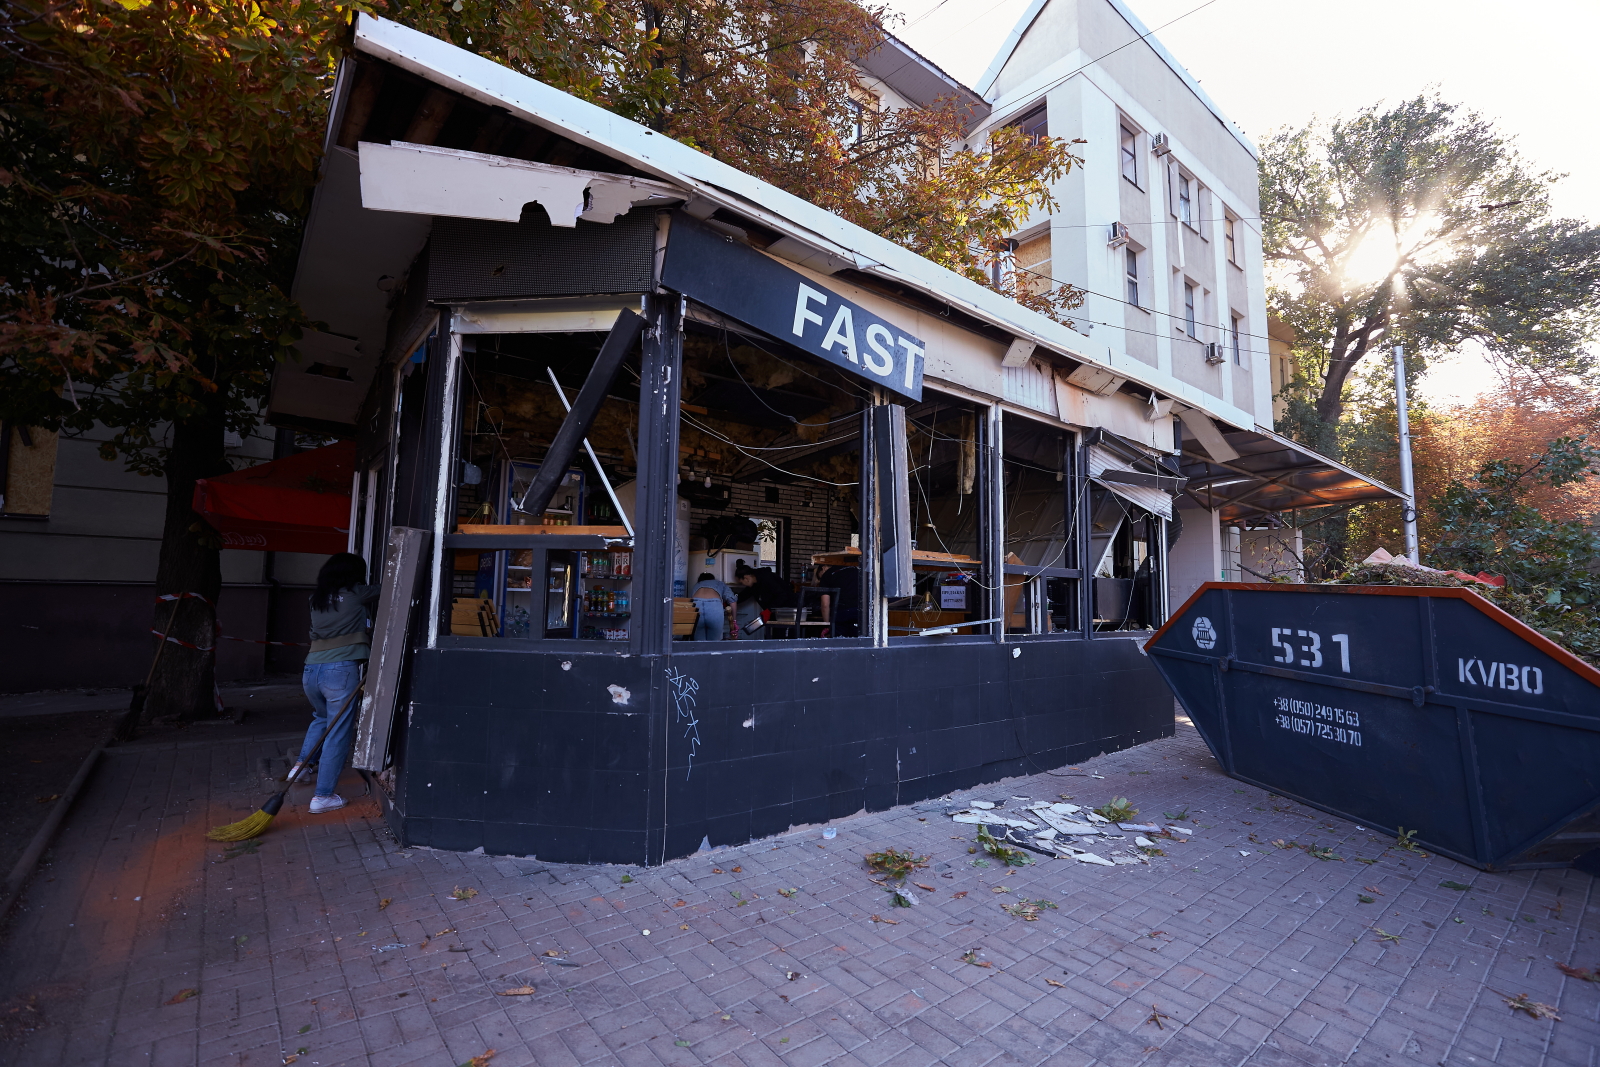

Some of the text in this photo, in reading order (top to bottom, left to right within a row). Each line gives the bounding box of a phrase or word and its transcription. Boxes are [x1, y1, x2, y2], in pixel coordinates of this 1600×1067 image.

[792, 282, 925, 390] FAST
[1271, 627, 1350, 673] 531
[1458, 657, 1543, 695] KVBO
[1273, 696, 1360, 727] +38 (050) 249 15 63
[1275, 714, 1362, 747] +38 (057) 725 30 70
